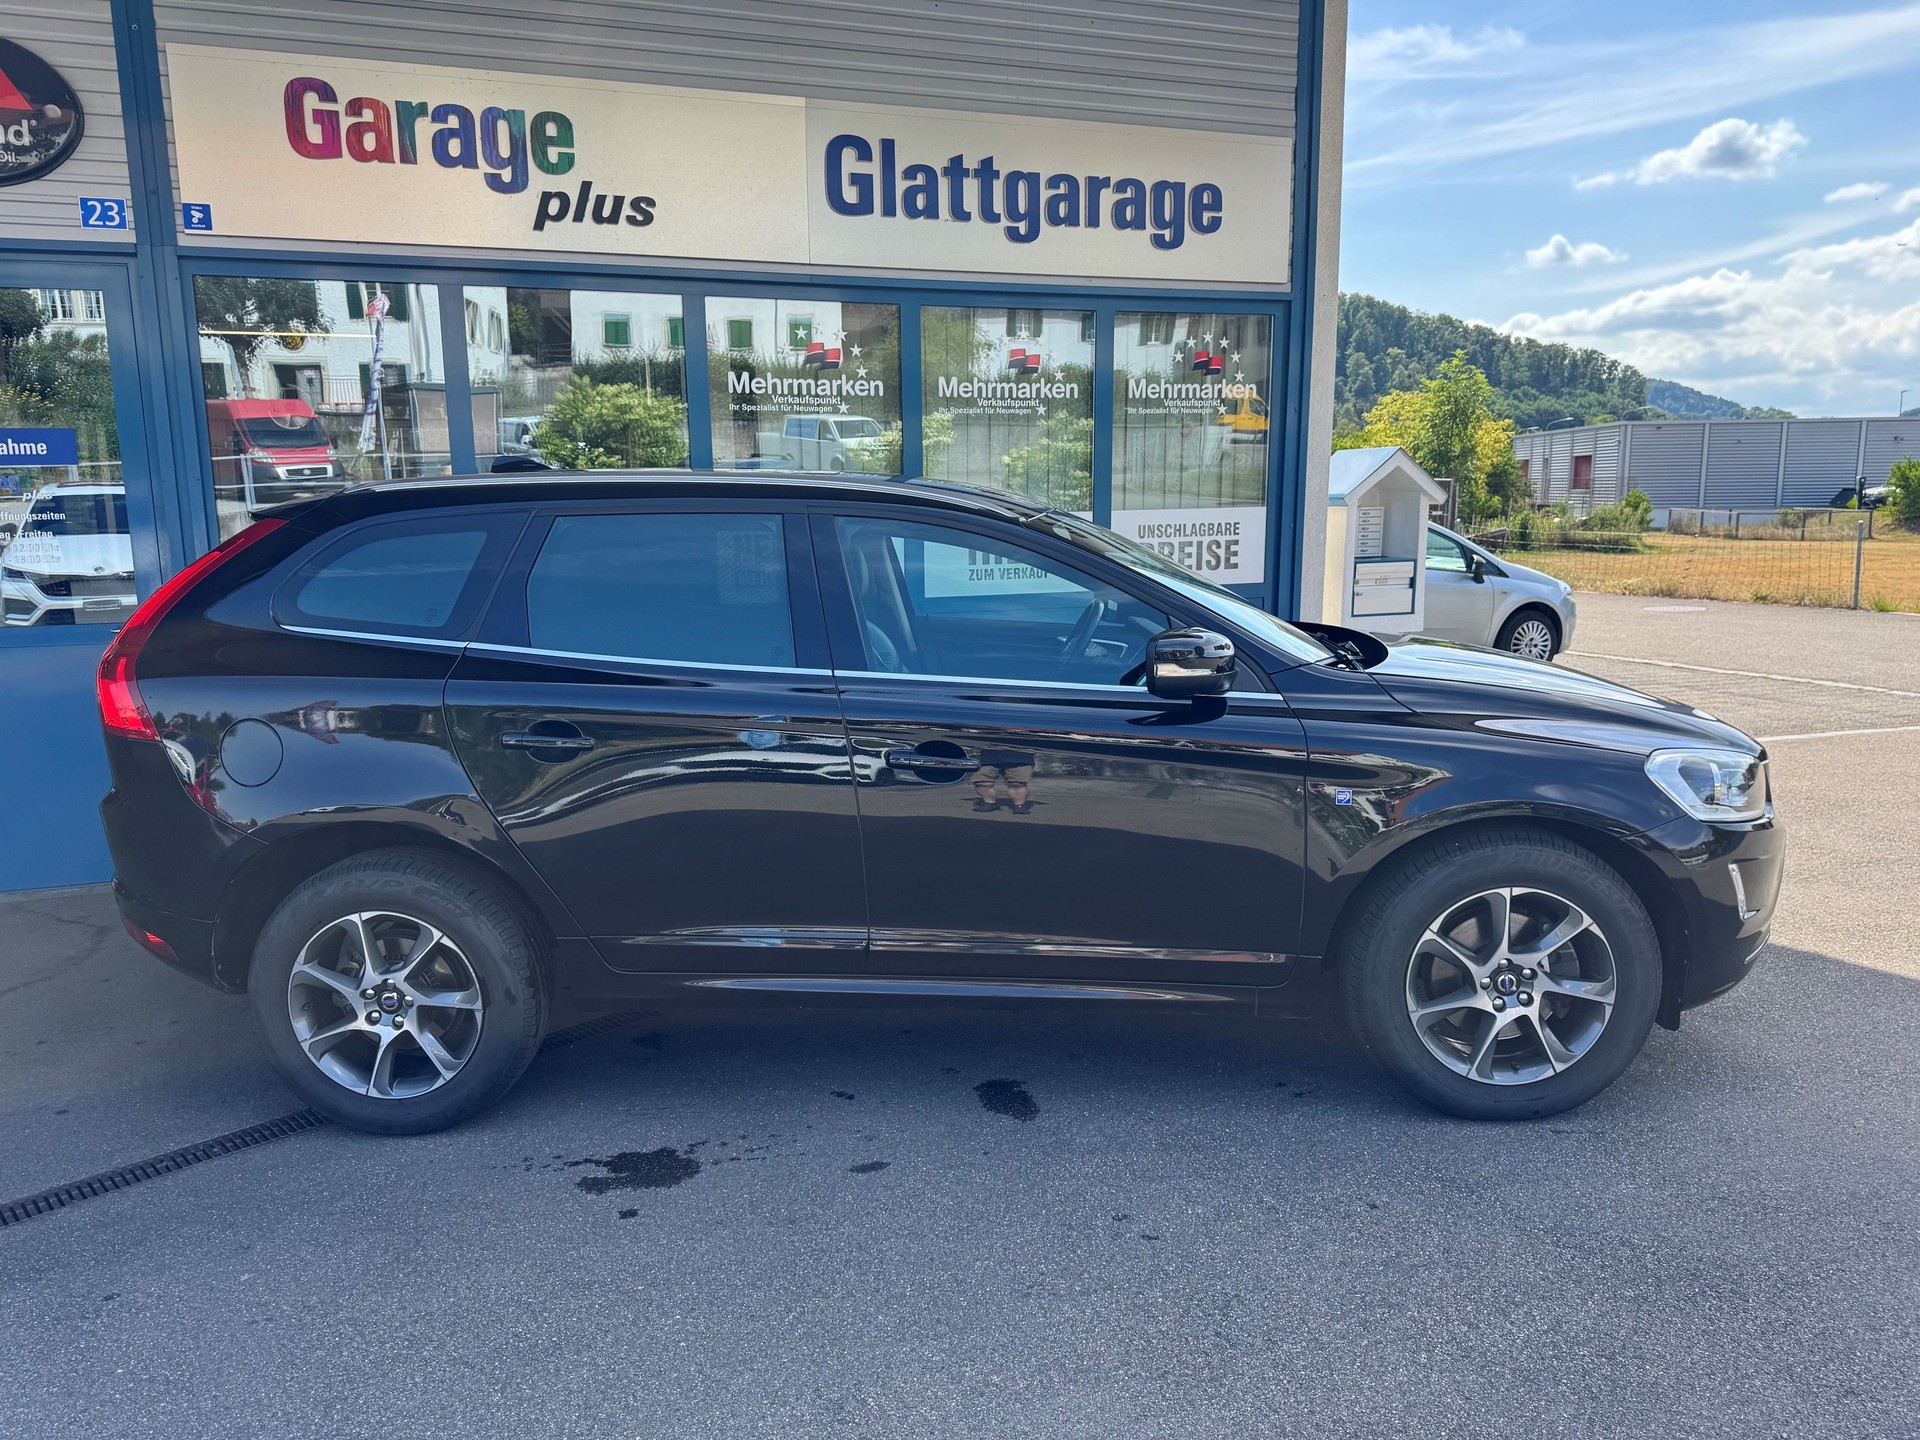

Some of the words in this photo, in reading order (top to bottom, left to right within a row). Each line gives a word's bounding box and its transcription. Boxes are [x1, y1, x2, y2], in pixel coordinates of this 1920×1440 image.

[283, 76, 575, 194] Garage
[824, 133, 1223, 251] Glattgarage
[532, 180, 657, 231] plus
[86, 200, 121, 226] 23
[727, 371, 884, 397] Mehrmarken
[938, 376, 1079, 399] Mehrmarken
[1128, 378, 1257, 399] Mehrmarken
[771, 394, 841, 406] Verkaufspunkt
[977, 398, 1040, 408] Verkaufspunkt
[1163, 398, 1221, 408] Verkaufspunkt
[729, 403, 739, 411] Ihr
[742, 403, 779, 413] Spezialist
[780, 404, 792, 412] für
[793, 404, 833, 414] Neuwagen
[950, 407, 983, 415] Spezialist
[996, 407, 1032, 415] Neuwagen
[1138, 407, 1169, 415] Spezialist
[1181, 407, 1214, 415] Neuwagen
[22, 490, 54, 502] plus
[20, 530, 54, 539] Freitag
[1137, 522, 1240, 539] UNSCHLAGBARE
[968, 568, 994, 581] ZUM
